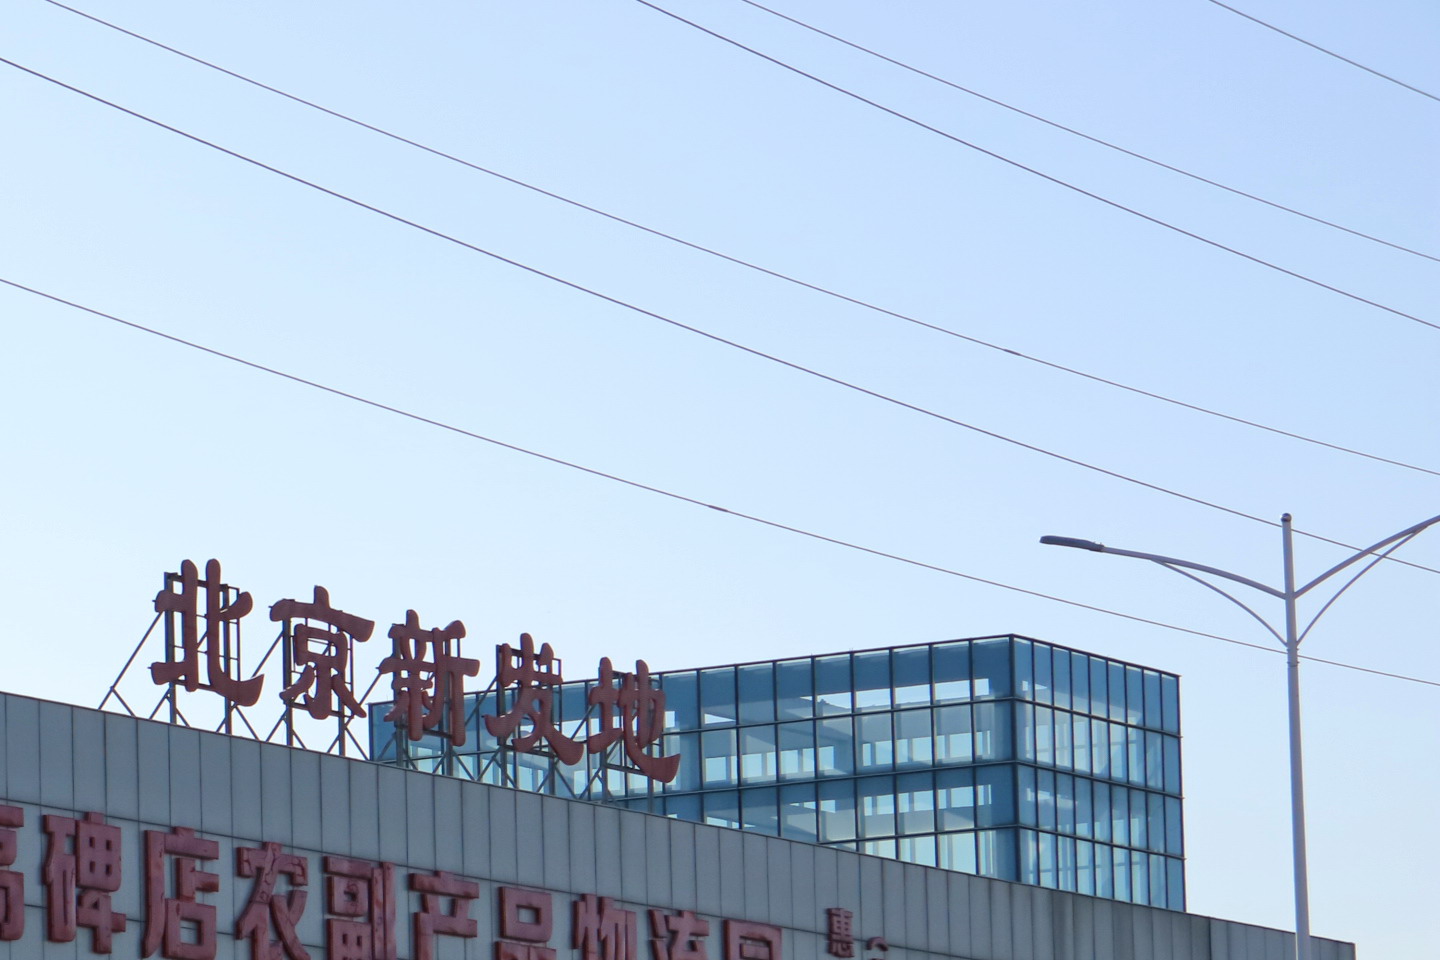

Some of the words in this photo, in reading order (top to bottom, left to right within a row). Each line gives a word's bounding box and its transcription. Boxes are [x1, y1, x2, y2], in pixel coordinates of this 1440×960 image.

[150, 559, 680, 783] 北京新发地
